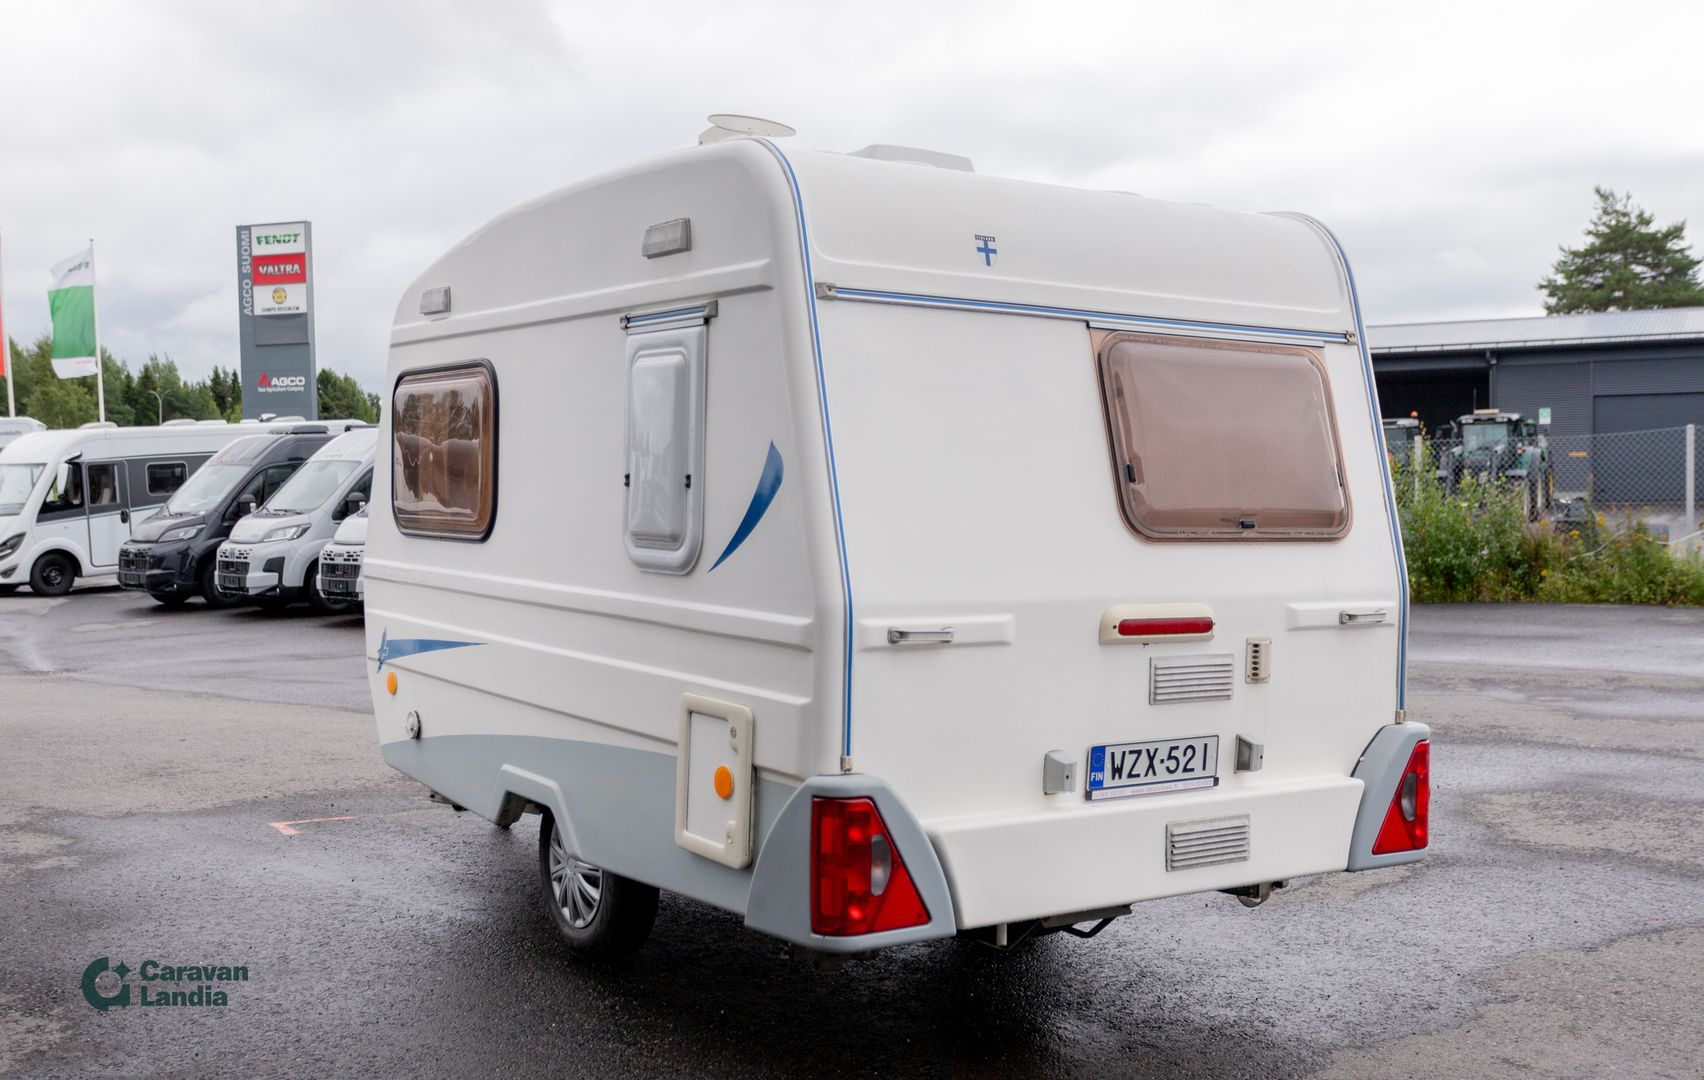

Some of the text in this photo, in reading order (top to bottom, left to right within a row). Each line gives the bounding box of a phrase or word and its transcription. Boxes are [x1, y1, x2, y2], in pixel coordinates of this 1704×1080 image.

[256, 233, 300, 245] FENDT
[240, 230, 253, 316] AGCO SUOMI
[258, 264, 301, 275] VALTRA
[272, 376, 305, 386] AGCO
[1090, 771, 1104, 782] FIN
